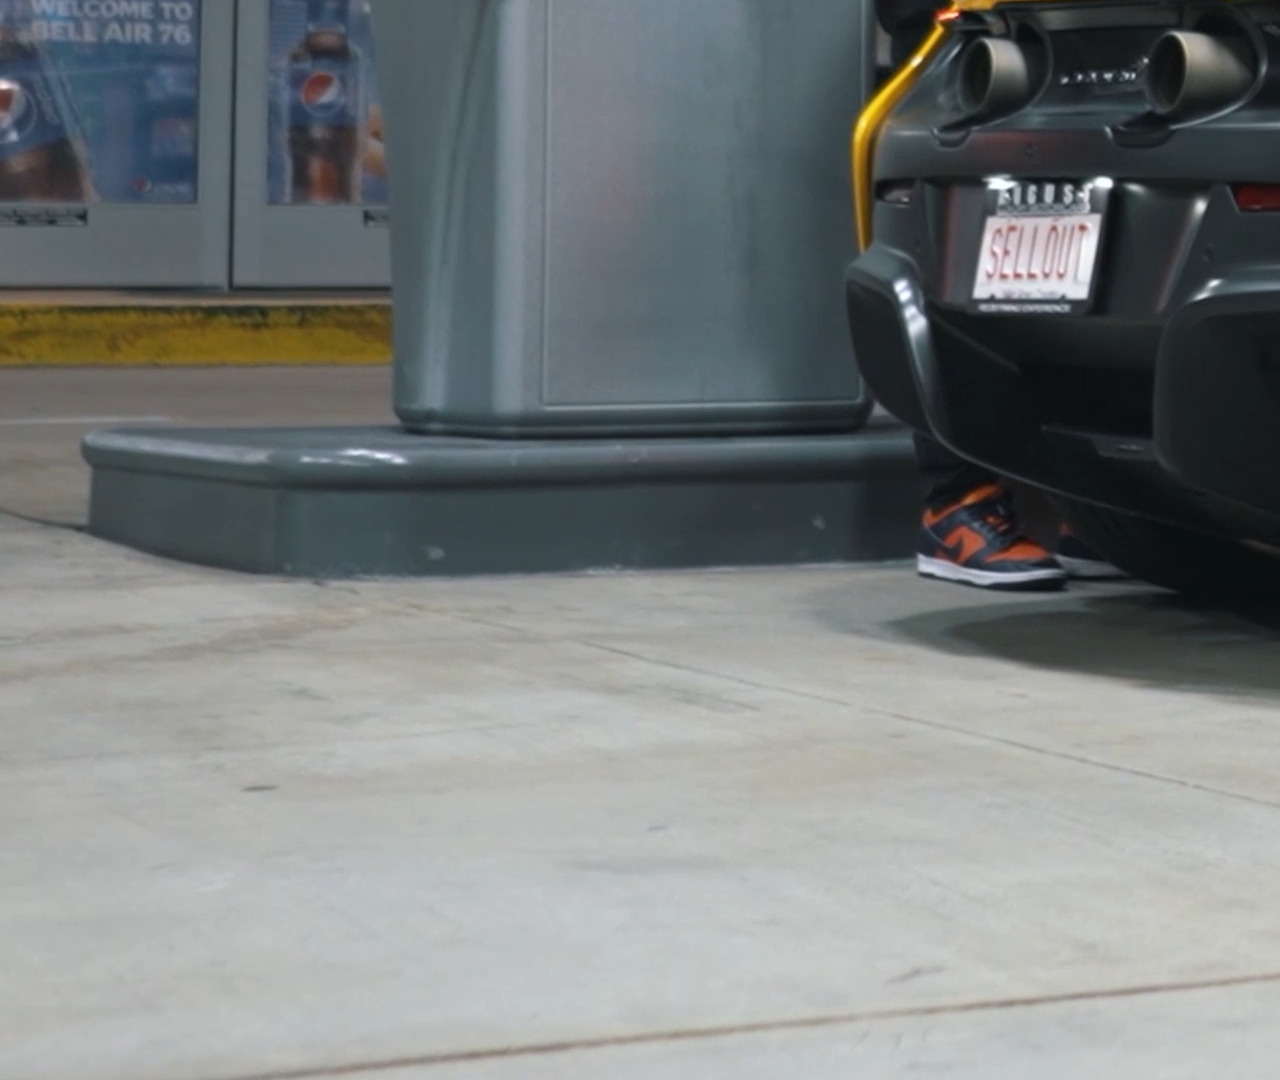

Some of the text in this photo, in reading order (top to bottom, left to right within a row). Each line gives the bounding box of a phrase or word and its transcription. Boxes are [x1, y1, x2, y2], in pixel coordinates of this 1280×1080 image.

[159, 1, 193, 21] TO
[31, 19, 192, 46] BELL AIR 76
[986, 223, 1090, 281] SELLOUT
